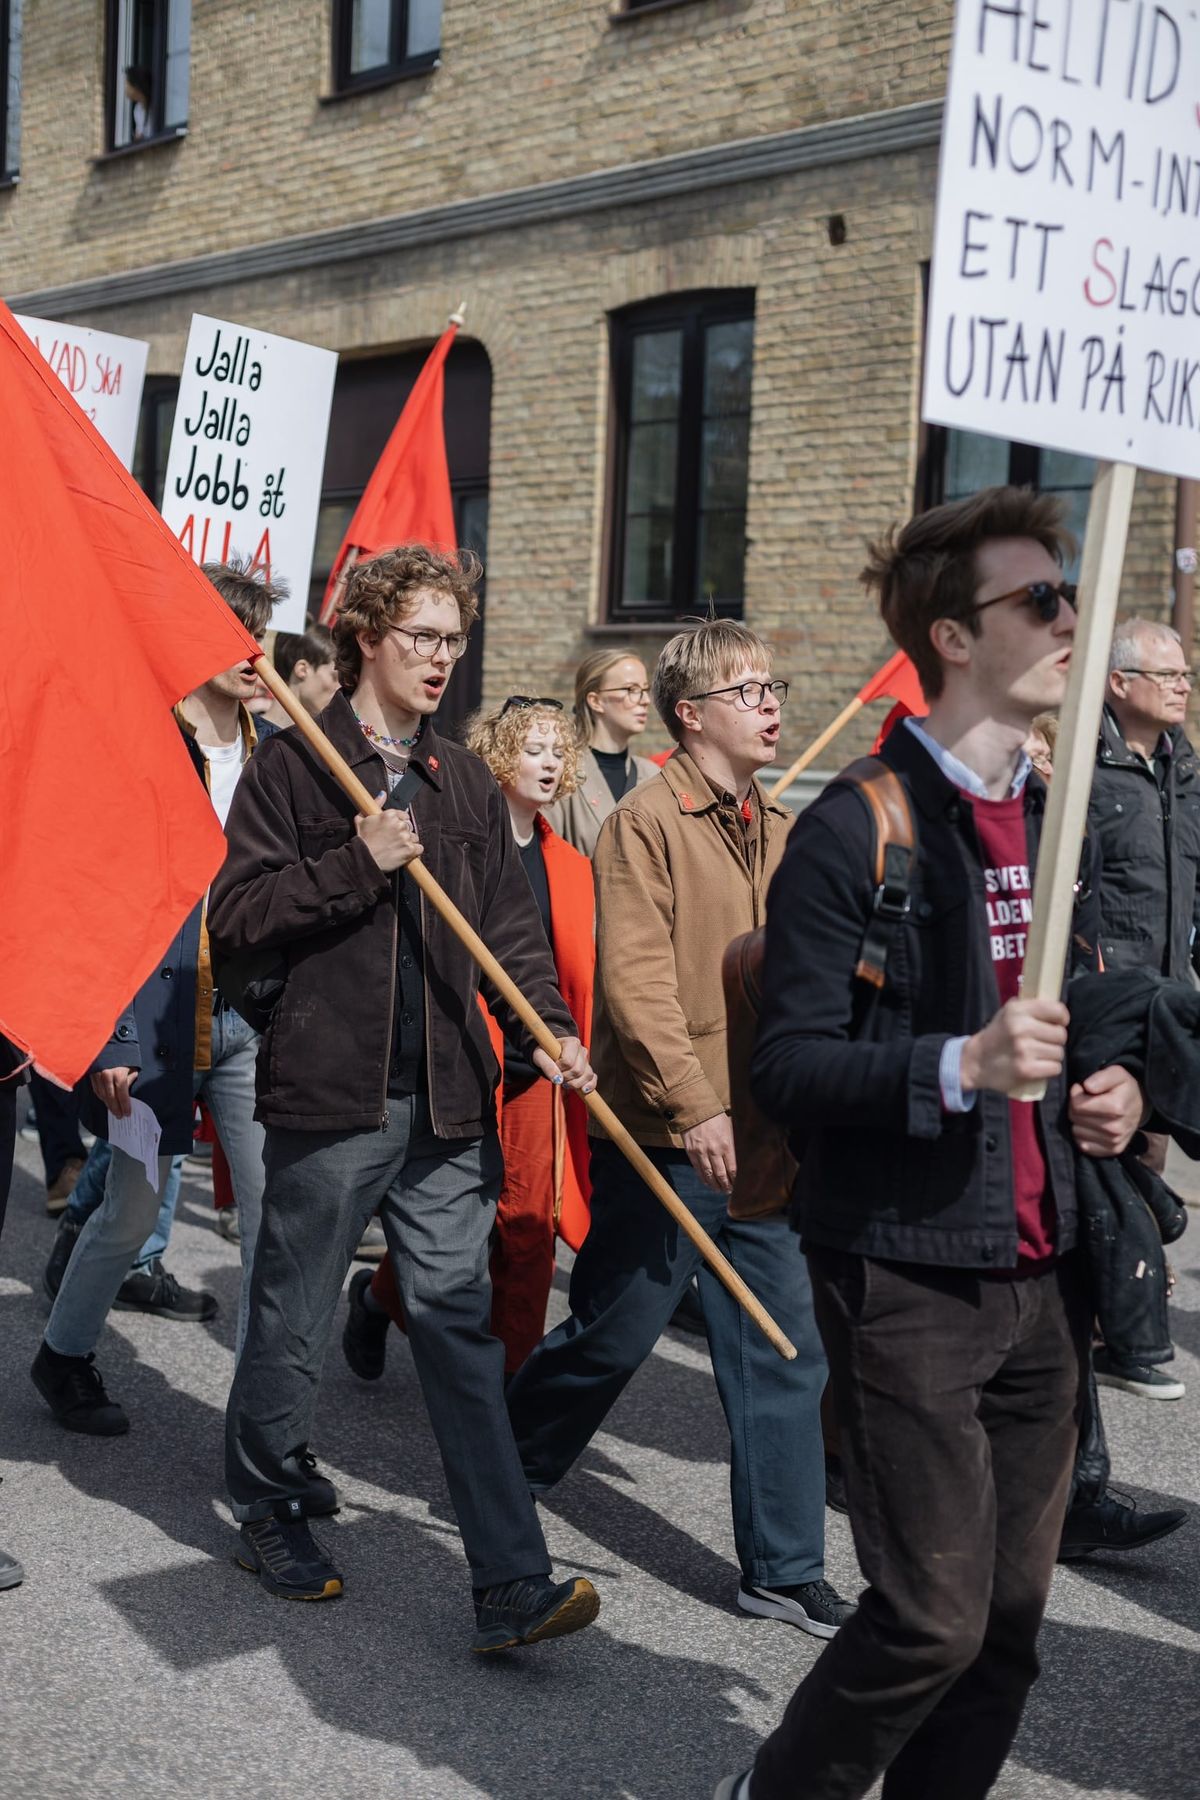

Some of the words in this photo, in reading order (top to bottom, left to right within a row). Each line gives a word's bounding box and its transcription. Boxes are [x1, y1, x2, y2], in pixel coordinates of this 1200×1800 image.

[960, 210, 1064, 292] ETT
[196, 329, 262, 391] Jalla
[944, 313, 1065, 402] UTAN
[1080, 324, 1126, 414] PÅ
[1144, 349, 1200, 430] RIK
[185, 391, 250, 446] Jalla
[175, 445, 249, 511] Jobb
[259, 468, 285, 518] åt
[990, 932, 1027, 961] BET
